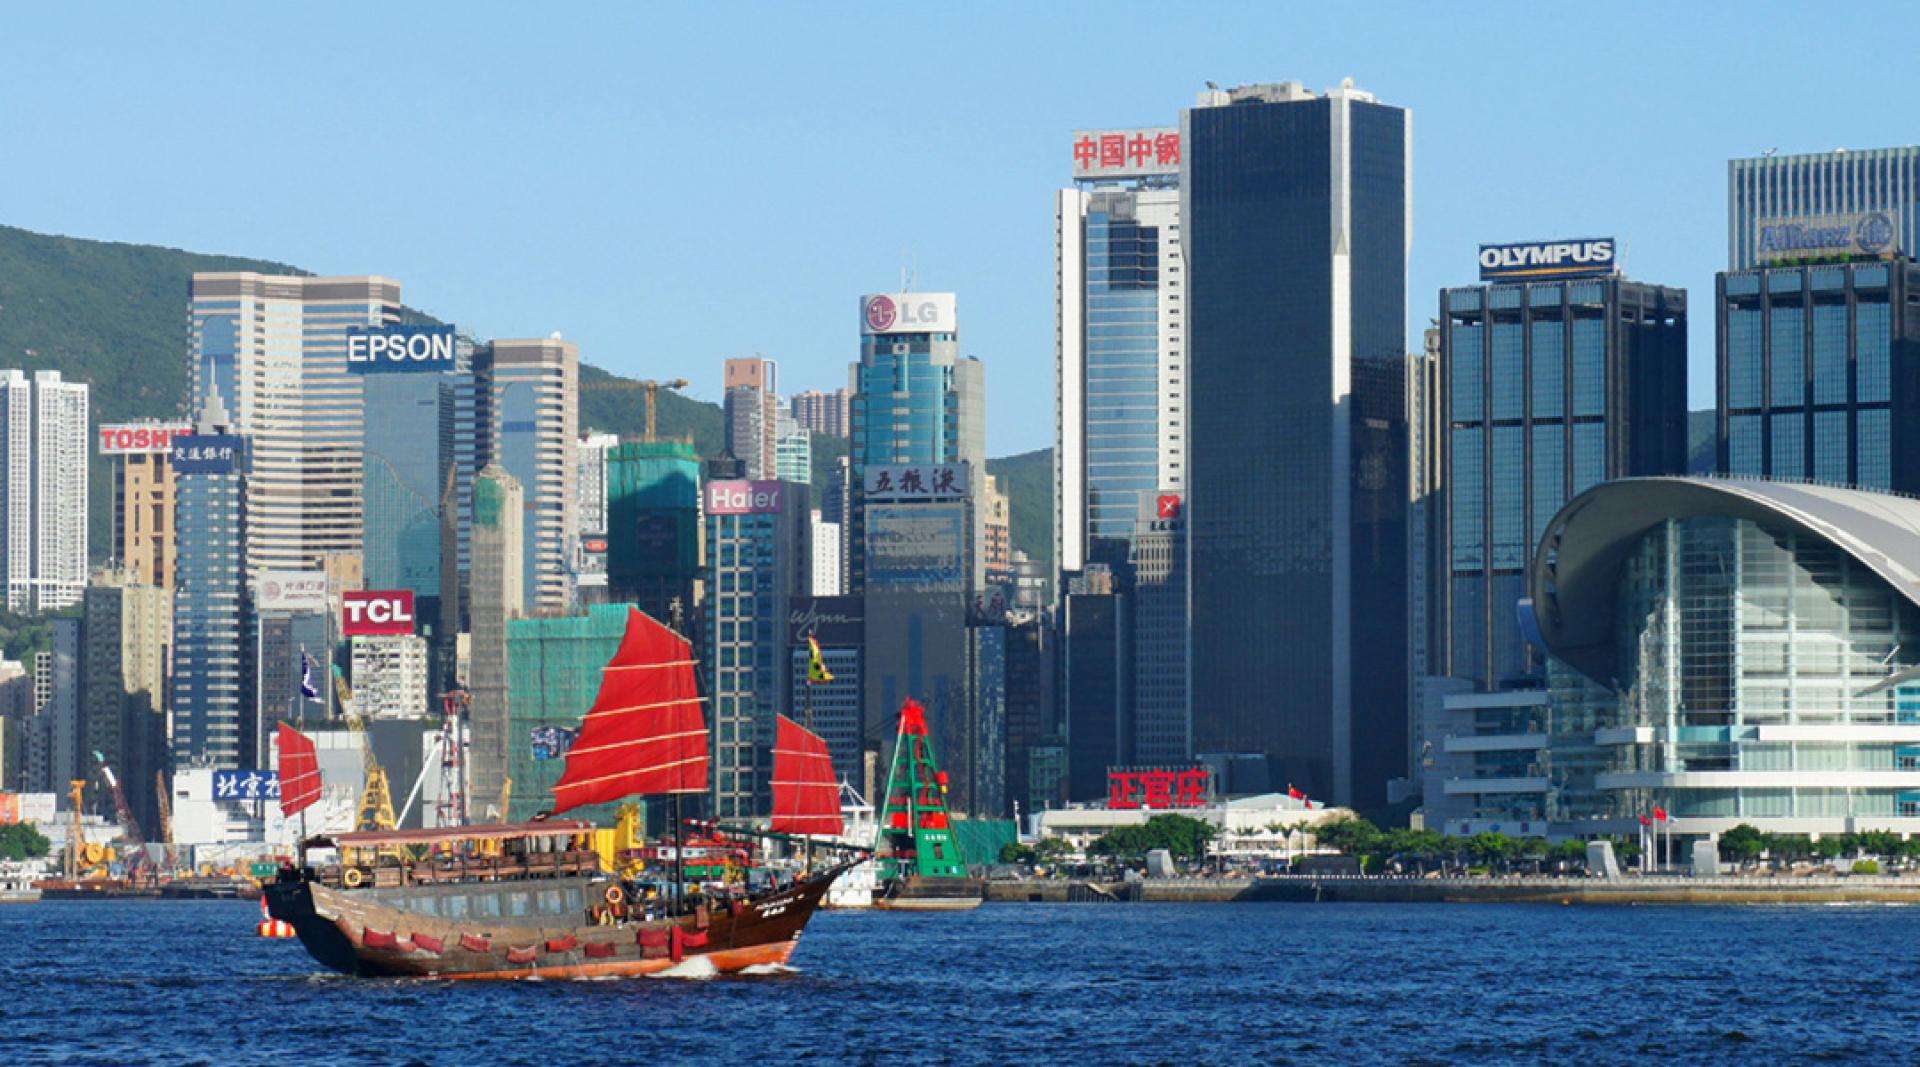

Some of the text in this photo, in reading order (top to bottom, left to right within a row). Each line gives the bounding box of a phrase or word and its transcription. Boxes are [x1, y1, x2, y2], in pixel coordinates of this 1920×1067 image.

[1074, 133, 1181, 169] 中国中钢
[1761, 224, 1851, 251] Allianz
[1480, 242, 1612, 268] OLYMPUS
[902, 302, 938, 322] LG
[349, 334, 452, 361] EPSON
[101, 428, 193, 448] TOSH
[864, 468, 963, 494] 五粮液
[712, 487, 779, 508] Haier
[344, 599, 411, 622] TCL
[1107, 768, 1209, 808] 正官庄
